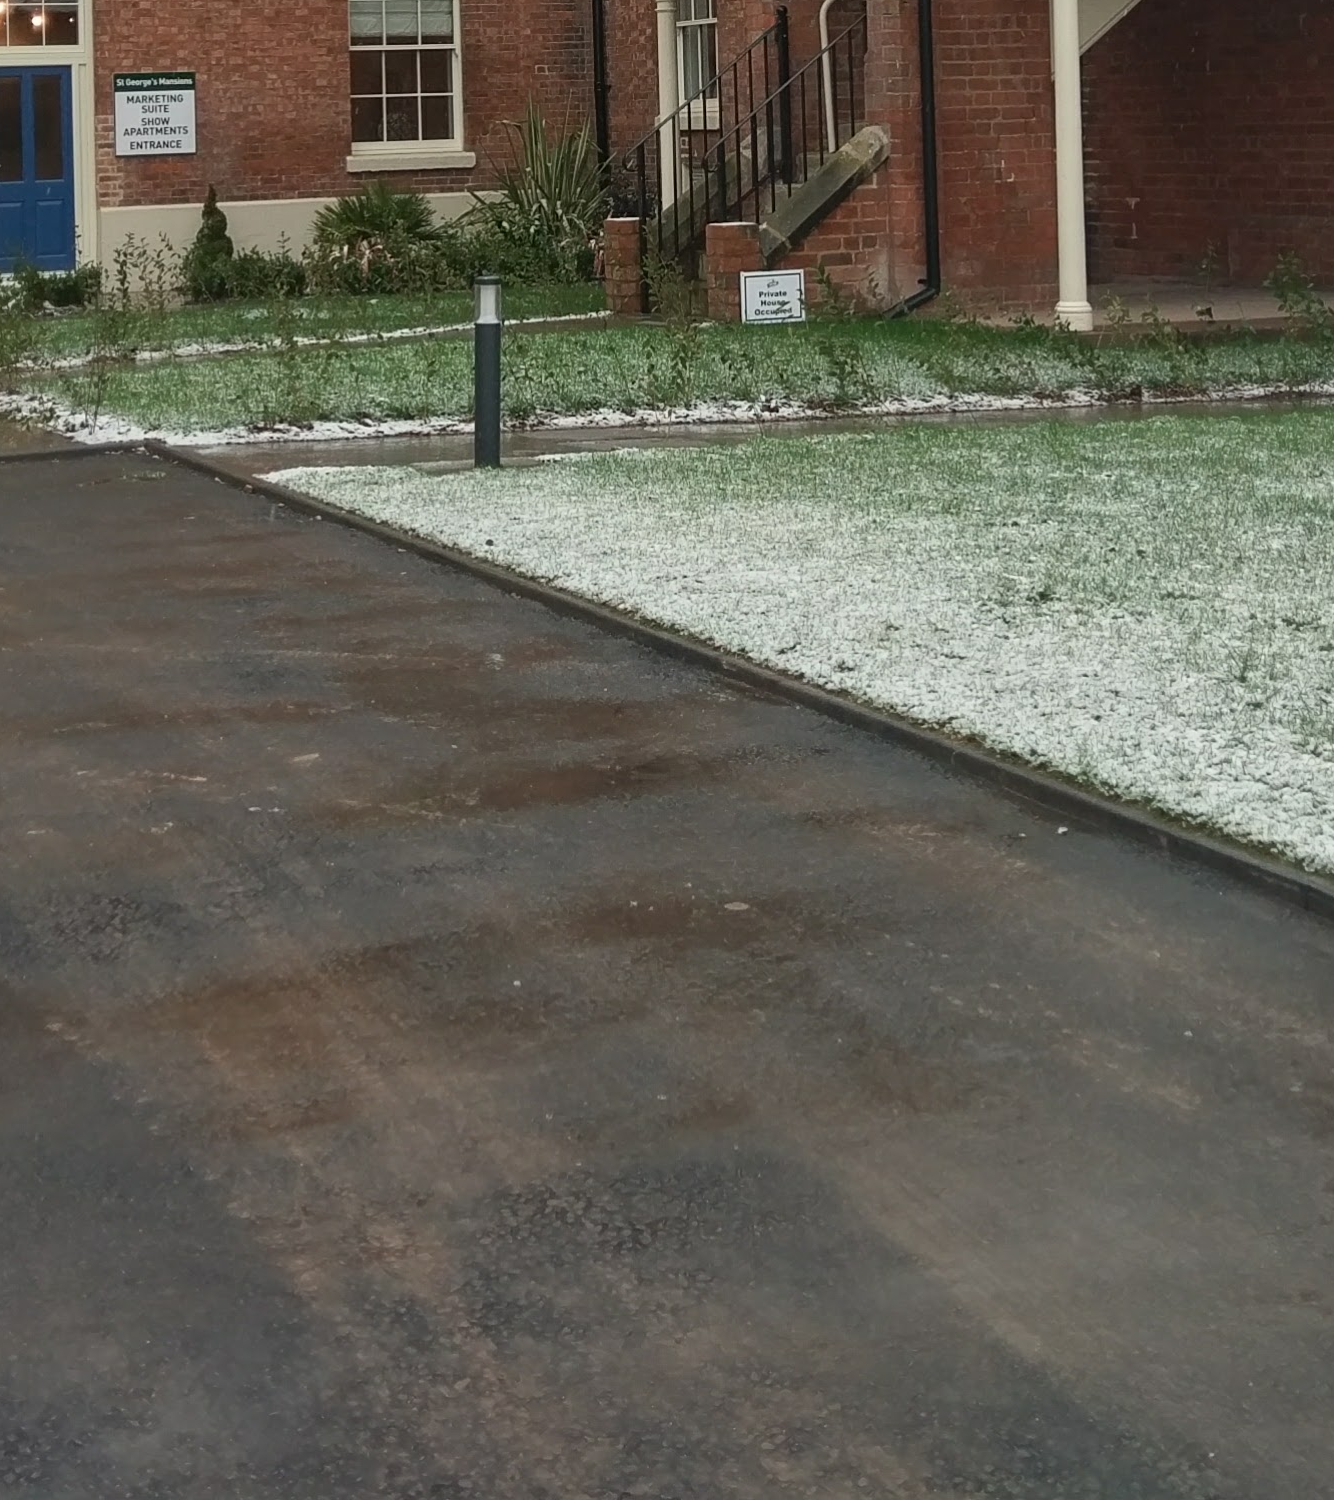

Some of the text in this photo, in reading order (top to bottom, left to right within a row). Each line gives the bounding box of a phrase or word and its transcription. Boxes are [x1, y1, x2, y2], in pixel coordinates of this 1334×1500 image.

[126, 78, 157, 87] George's
[159, 77, 193, 85] Mansions
[126, 94, 183, 104] MARKETING
[141, 105, 169, 113] SUITE
[141, 117, 170, 126] SHOW
[123, 126, 188, 136] APARTMENTS
[130, 140, 182, 150] ENTRANCE
